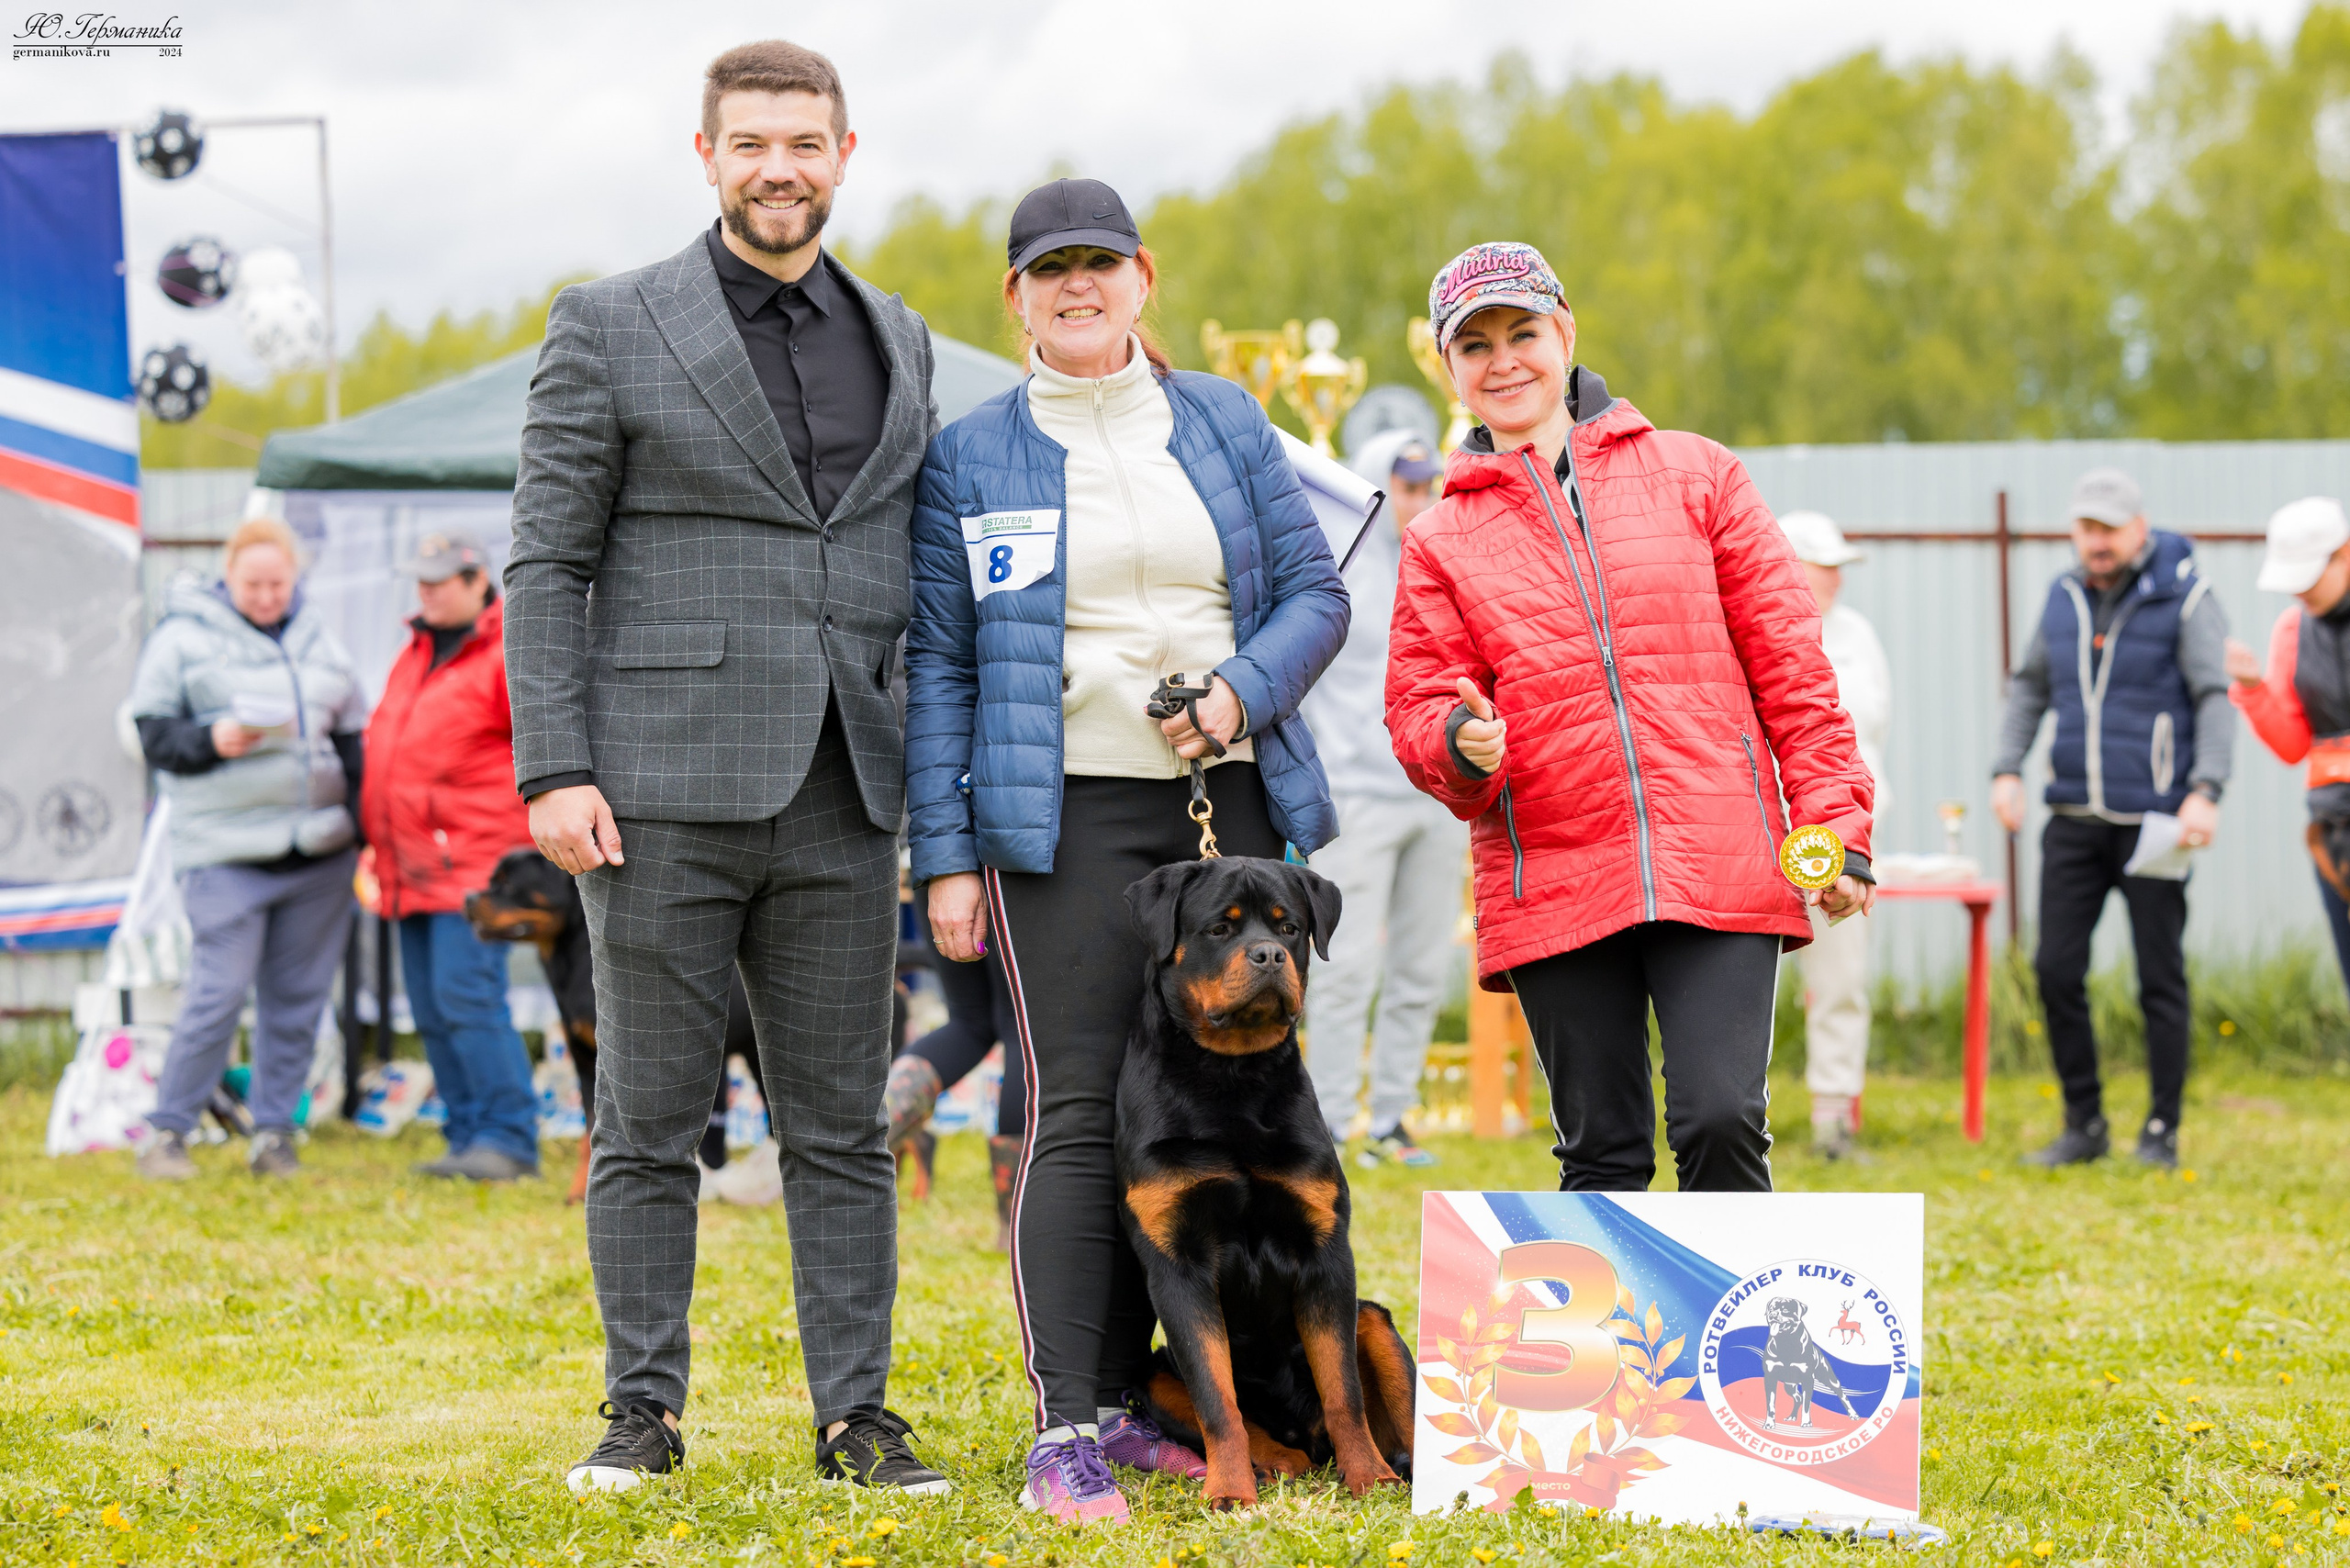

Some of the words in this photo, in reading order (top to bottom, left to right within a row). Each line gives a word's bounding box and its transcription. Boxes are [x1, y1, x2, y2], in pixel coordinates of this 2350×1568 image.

[1438, 252, 1529, 301] Madrid
[989, 545, 1013, 583] 8
[1493, 1240, 1621, 1414] 3
[1703, 1268, 1783, 1374] РОТВЕЙЛЕР
[1797, 1264, 1856, 1288] КЛУБ
[1863, 1288, 1907, 1375] РОССИИ
[1716, 1406, 1873, 1464] НИЖЕГОРОДСКОЕ
[1872, 1406, 1895, 1430] РО
[1530, 1482, 1572, 1491] место
